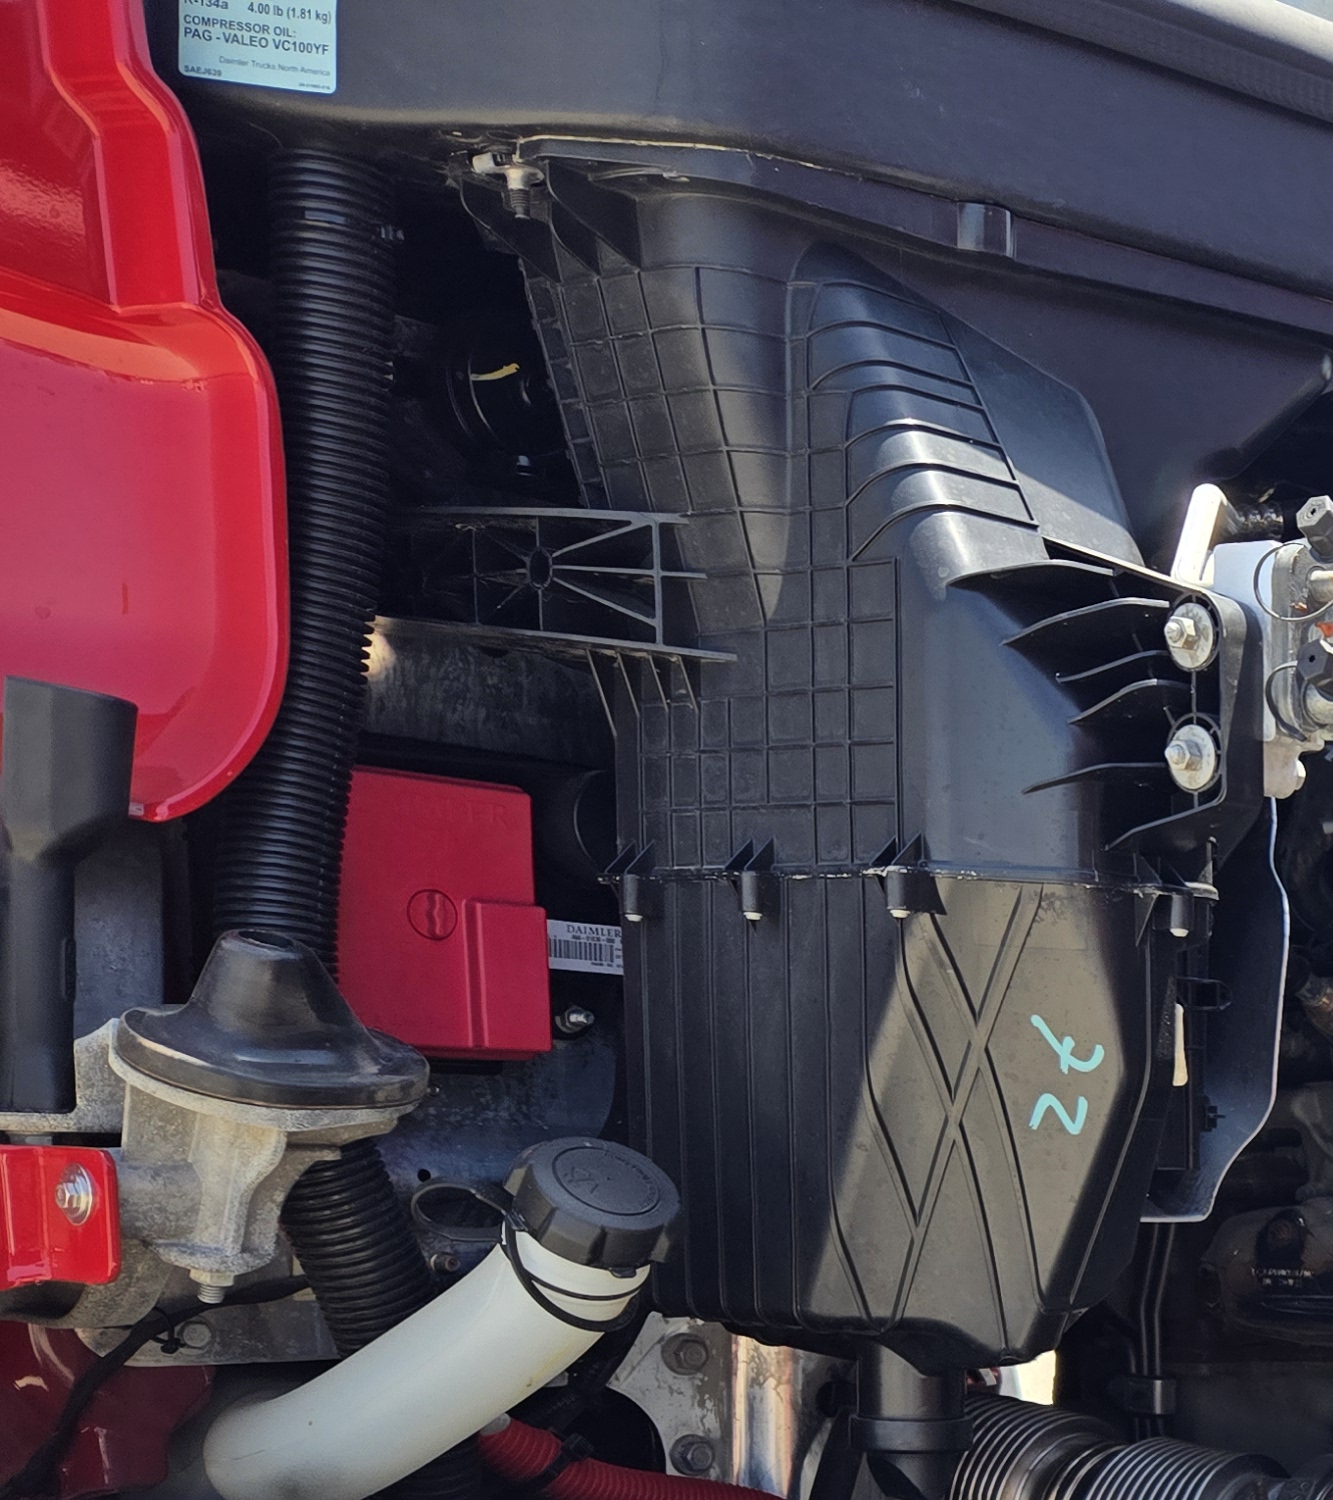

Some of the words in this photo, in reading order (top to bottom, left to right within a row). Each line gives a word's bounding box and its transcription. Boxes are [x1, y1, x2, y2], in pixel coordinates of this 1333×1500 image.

[248, 3, 270, 15] 4.00
[273, 5, 283, 16] lb
[287, 7, 312, 20] (1.81
[315, 10, 331, 24] kg)
[184, 14, 270, 35] COMPRESSOR
[274, 26, 296, 38] OIL:
[184, 27, 212, 41] PAG
[222, 32, 268, 48] VALEO
[273, 38, 329, 55] VC100YF
[219, 55, 248, 67] Daimler
[251, 59, 276, 71] Trucks
[278, 63, 299, 73] North
[300, 65, 331, 77] America
[566, 924, 622, 939] DAIMLER
